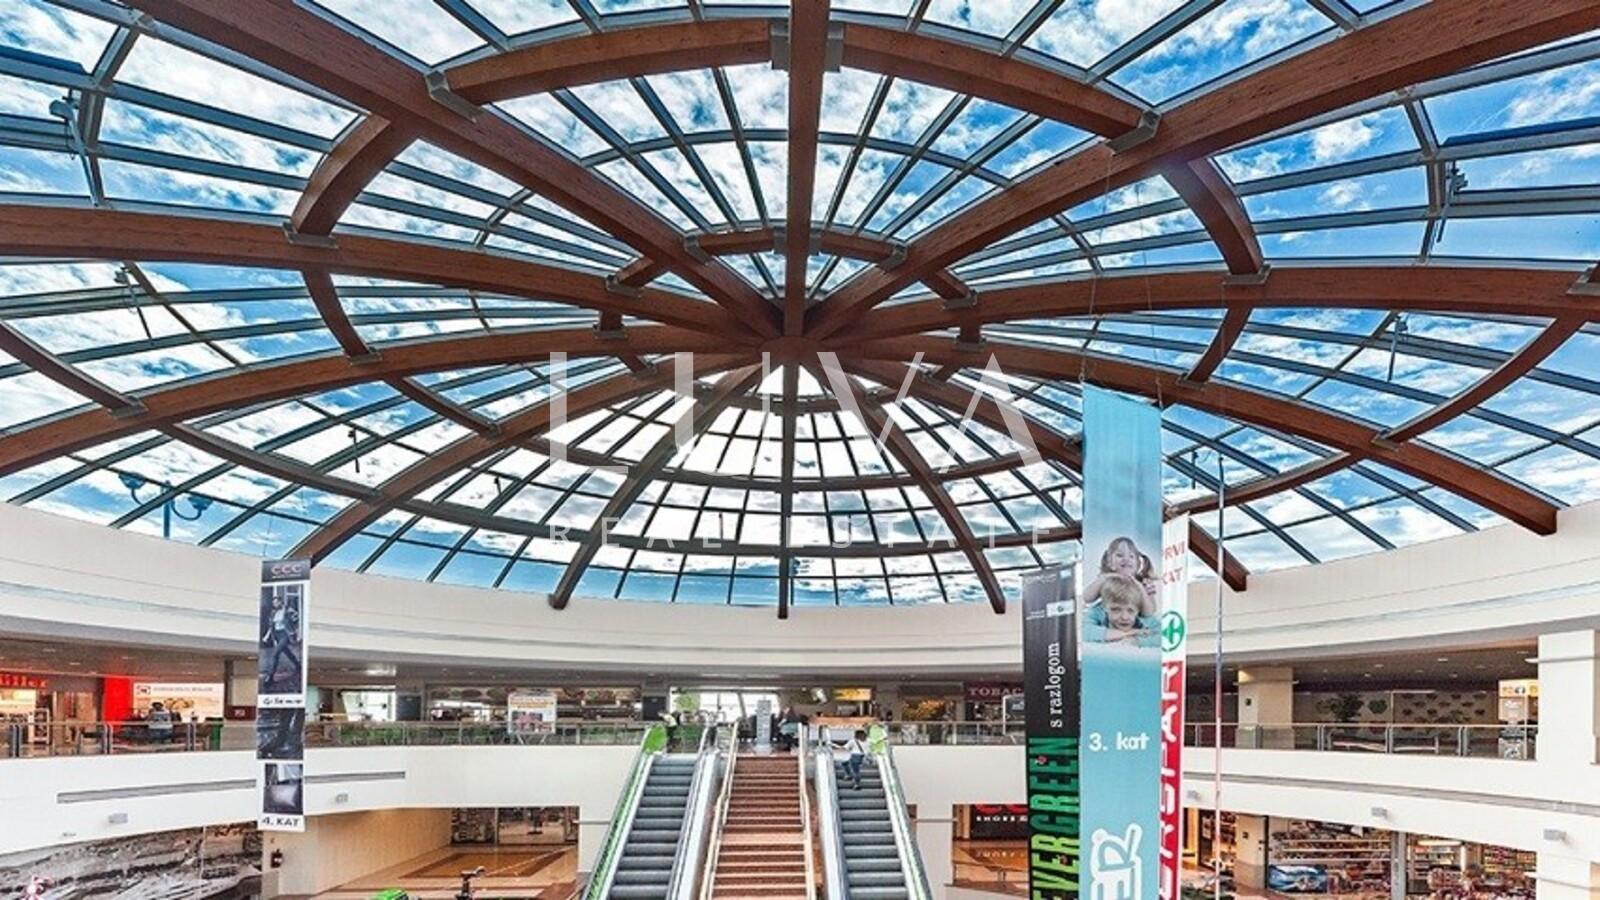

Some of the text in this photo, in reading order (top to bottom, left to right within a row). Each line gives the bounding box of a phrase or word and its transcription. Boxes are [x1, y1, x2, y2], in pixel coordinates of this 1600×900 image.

[271, 564, 302, 575] CCC
[1044, 642, 1065, 728] s razlogom
[1089, 732, 1149, 751] 3. kat
[262, 816, 300, 827] 4. KAT
